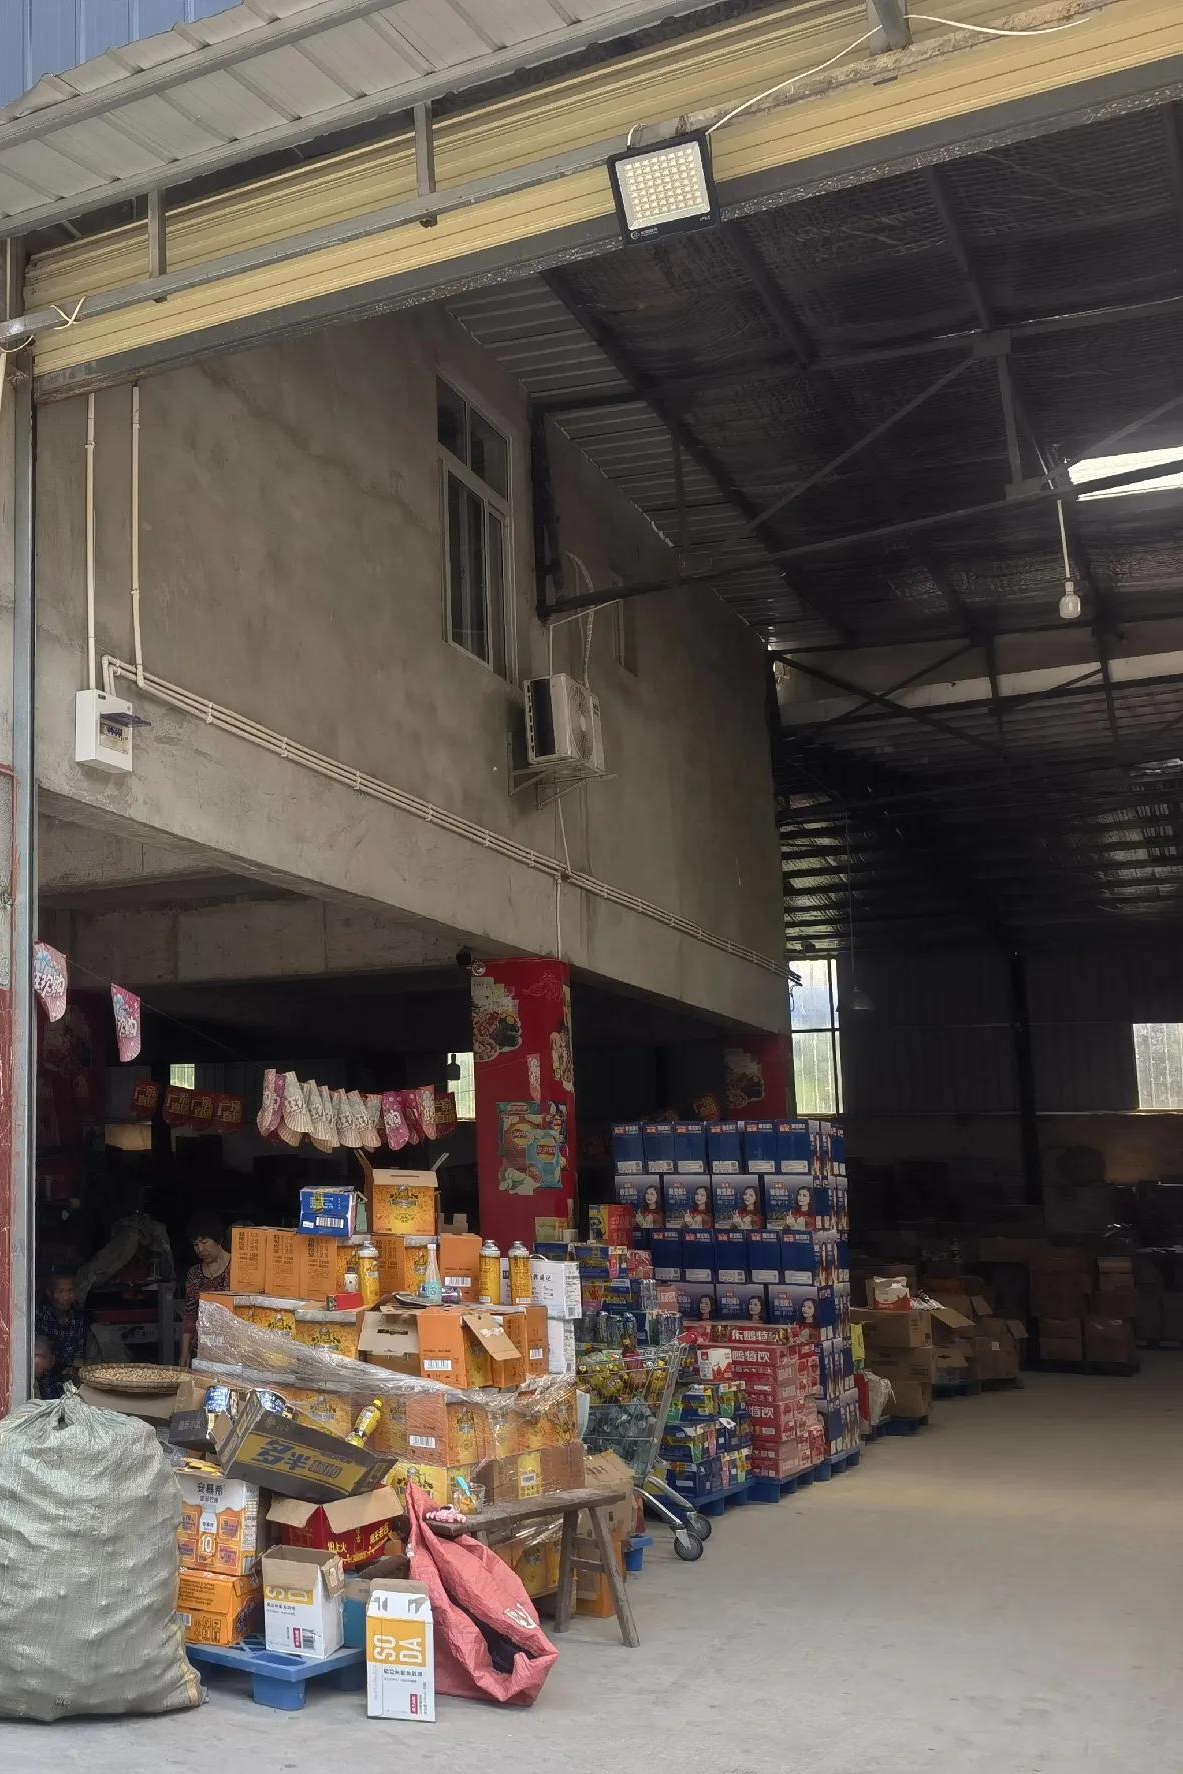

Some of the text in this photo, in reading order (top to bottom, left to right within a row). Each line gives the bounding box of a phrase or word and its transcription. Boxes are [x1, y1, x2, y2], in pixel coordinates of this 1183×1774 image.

[732, 1351, 770, 1362] 鹏特饮
[373, 1634, 397, 1662] SO
[399, 1637, 423, 1664] DA
